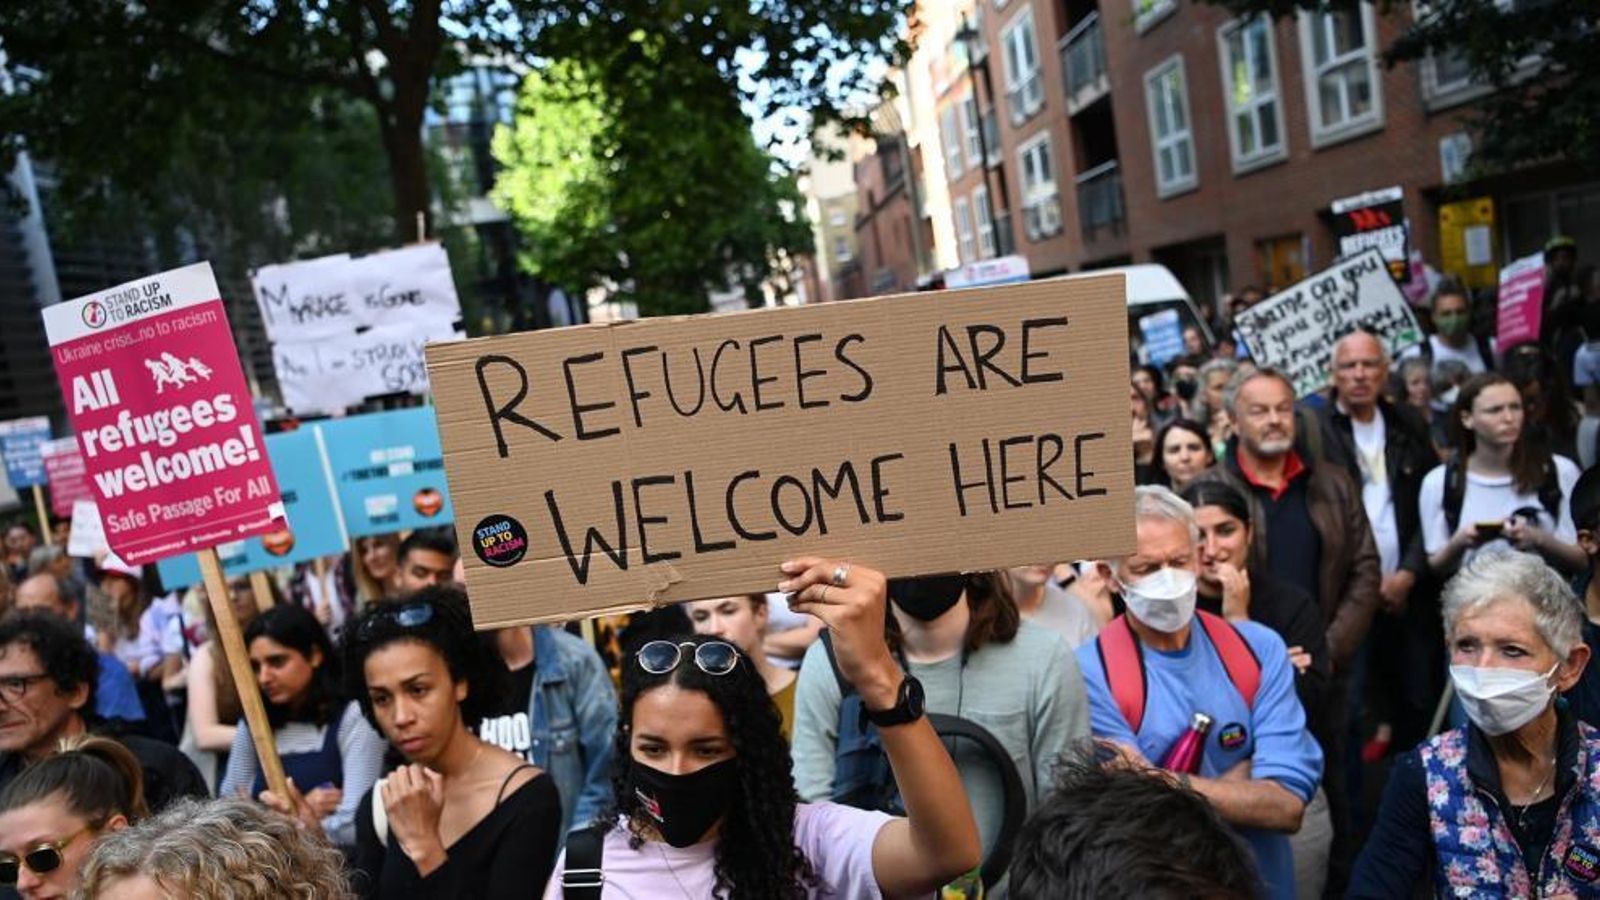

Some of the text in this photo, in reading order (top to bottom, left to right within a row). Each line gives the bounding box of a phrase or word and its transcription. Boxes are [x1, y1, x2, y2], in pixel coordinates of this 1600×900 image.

[104, 281, 161, 310] STAND UP
[109, 294, 173, 323] TO RACISM
[1238, 291, 1308, 337] Shame
[1310, 275, 1339, 300] on
[1341, 255, 1379, 289] you
[1272, 318, 1310, 354] you
[1313, 289, 1361, 331] offer
[57, 341, 102, 364] Ukraine
[157, 321, 171, 335] to
[172, 309, 218, 331] racism
[72, 368, 121, 416] All
[474, 333, 875, 459] REFUGEES
[935, 316, 1069, 397] ARE
[82, 394, 238, 458] refugees
[94, 424, 261, 499] welcome!
[107, 510, 148, 534] Safe
[148, 497, 214, 524] Passage
[214, 486, 242, 508] For
[247, 475, 272, 499] All
[476, 521, 511, 540] STAND
[544, 432, 1108, 586] WELCOME HERE
[481, 531, 513, 548] UP TO
[485, 536, 525, 558] RACISM
[479, 711, 532, 752] HOO
